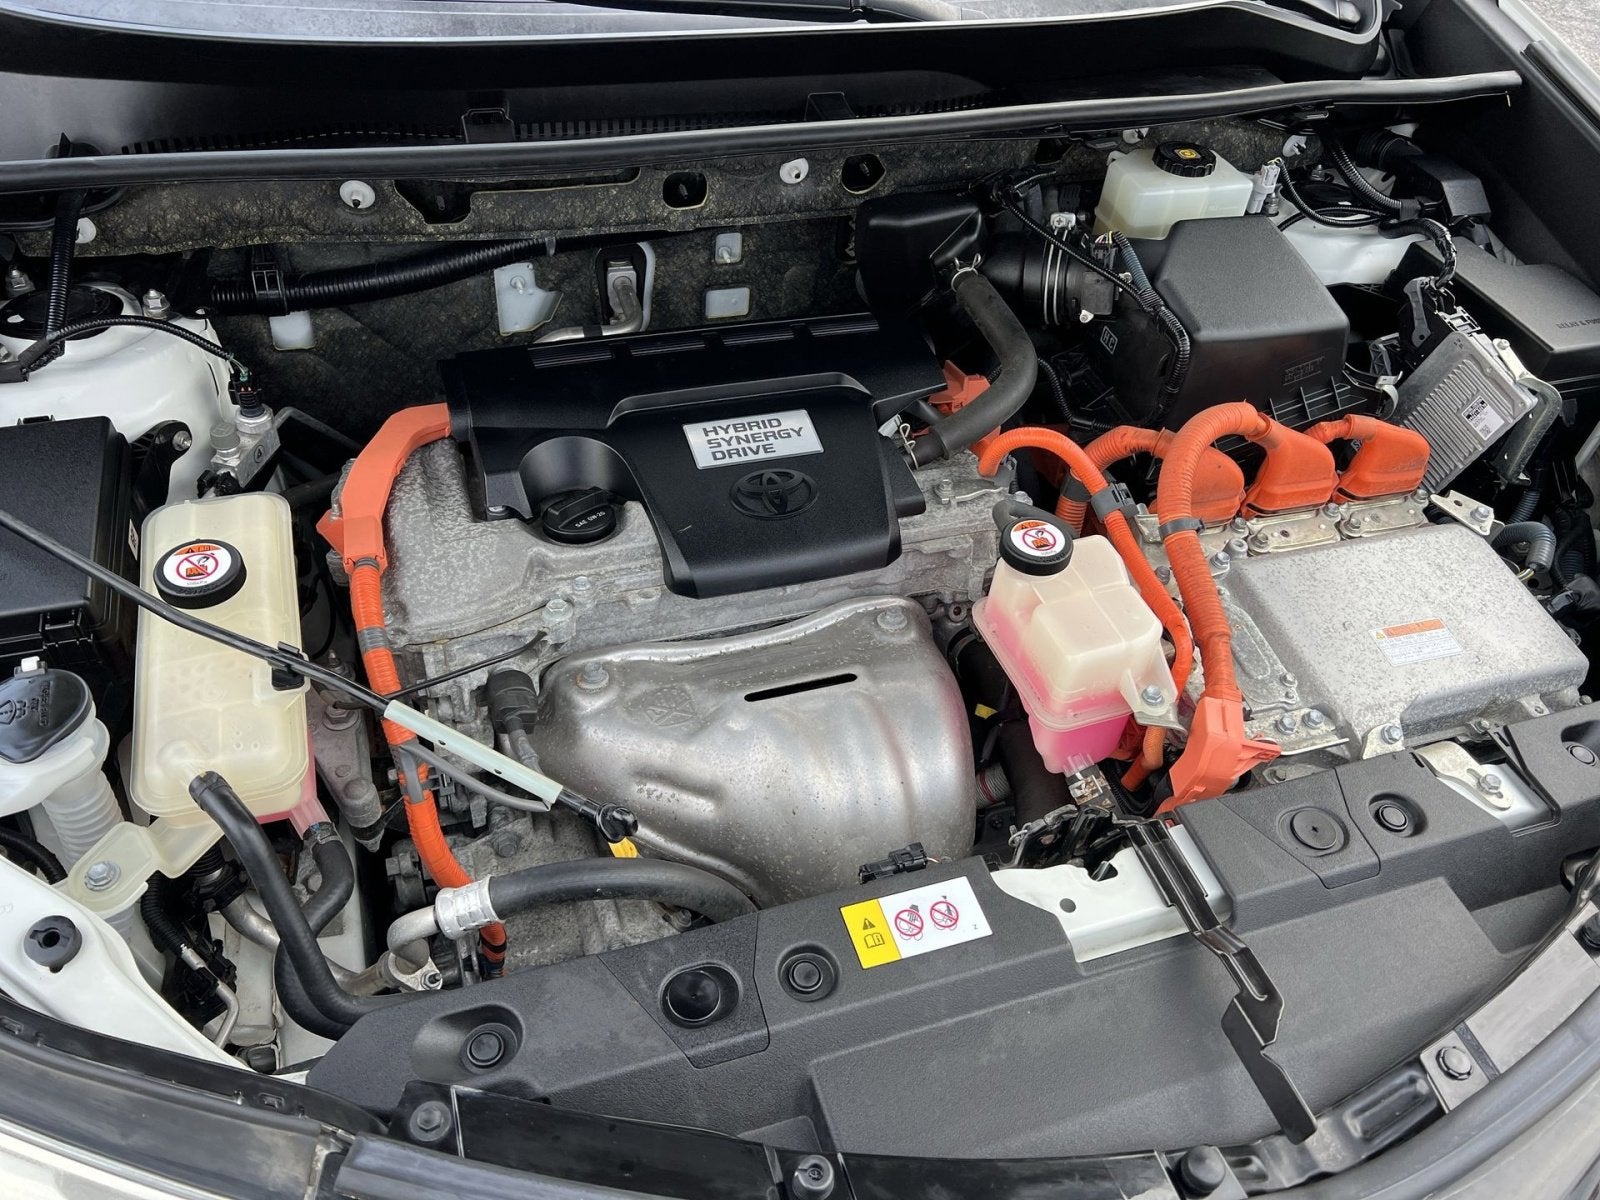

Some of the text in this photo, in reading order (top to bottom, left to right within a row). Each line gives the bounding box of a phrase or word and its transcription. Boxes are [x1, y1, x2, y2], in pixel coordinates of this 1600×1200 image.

[703, 418, 782, 437] HYBRID
[707, 426, 803, 449] SYNERGY
[711, 443, 777, 461] DRIVE
